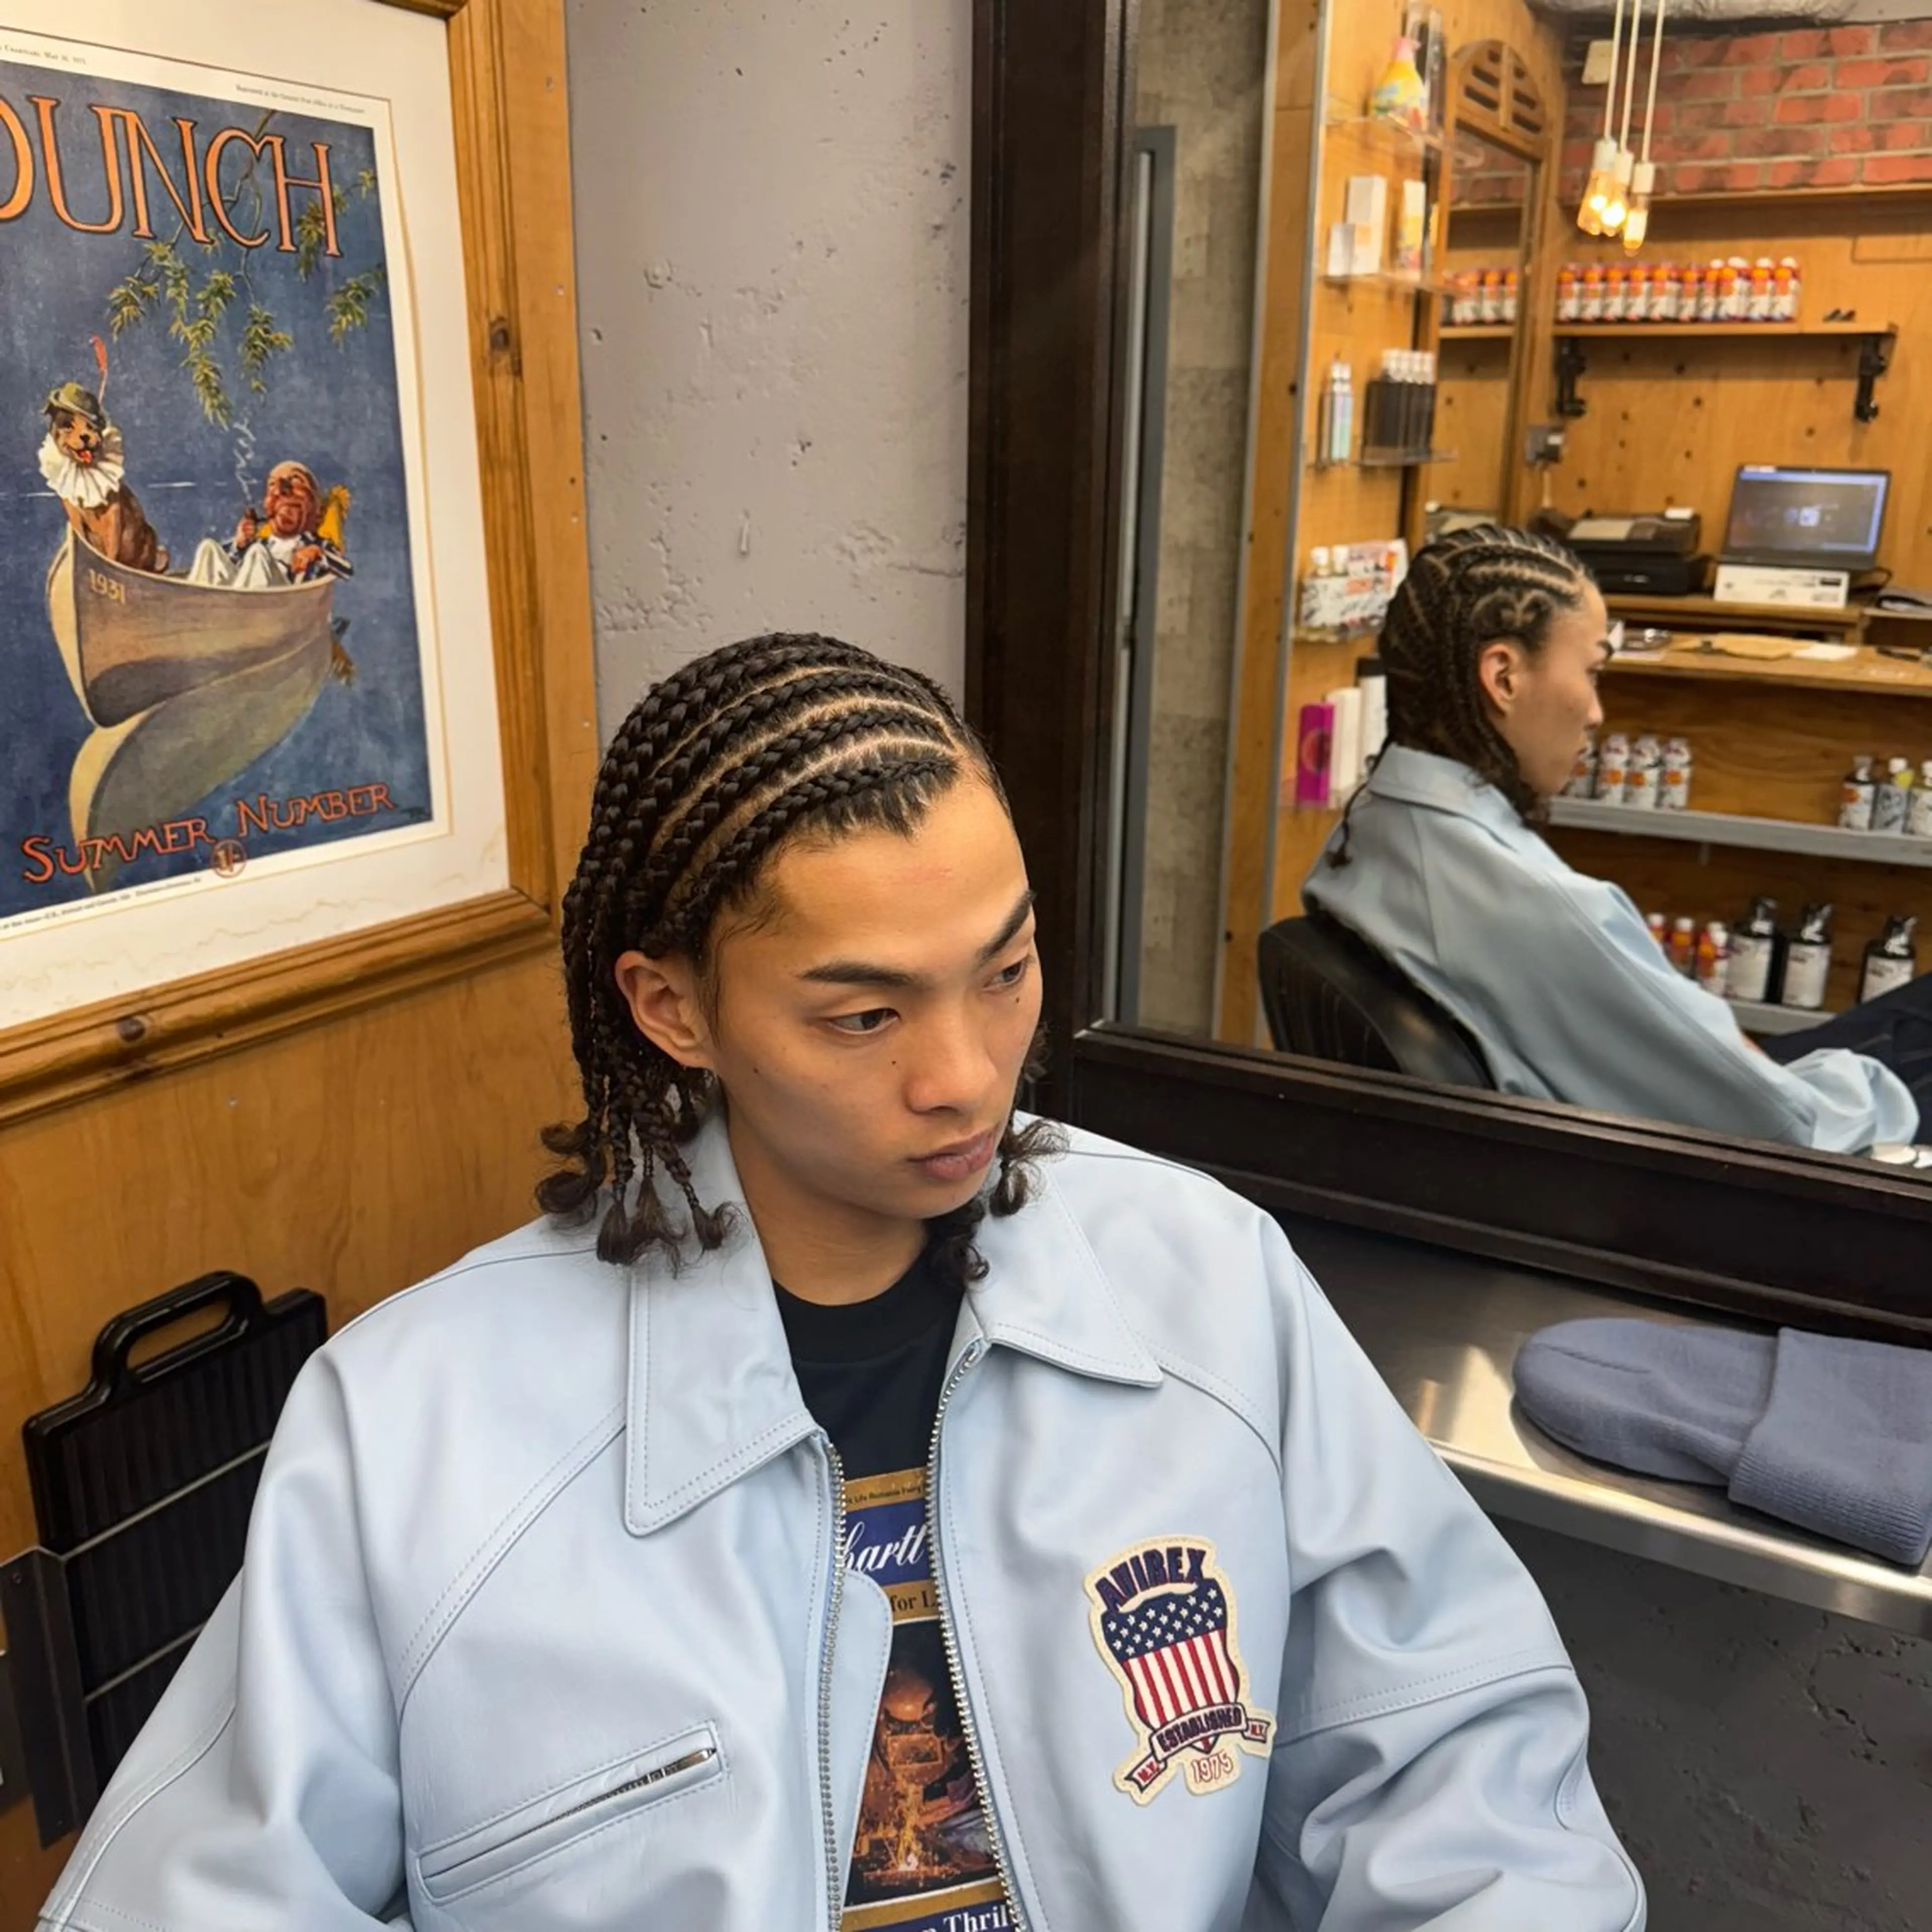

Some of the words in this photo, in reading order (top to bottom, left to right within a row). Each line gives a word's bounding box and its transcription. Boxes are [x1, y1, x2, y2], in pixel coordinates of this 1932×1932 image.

[22, 817, 216, 884] SUMMER
[236, 781, 395, 838] NUMBER
[842, 1521, 928, 1572] hartt
[1095, 1547, 1206, 1613] AVIREX
[890, 1593, 917, 1612] for
[1190, 1748, 1234, 1784] 1975
[943, 1904, 1013, 1932] Thril
